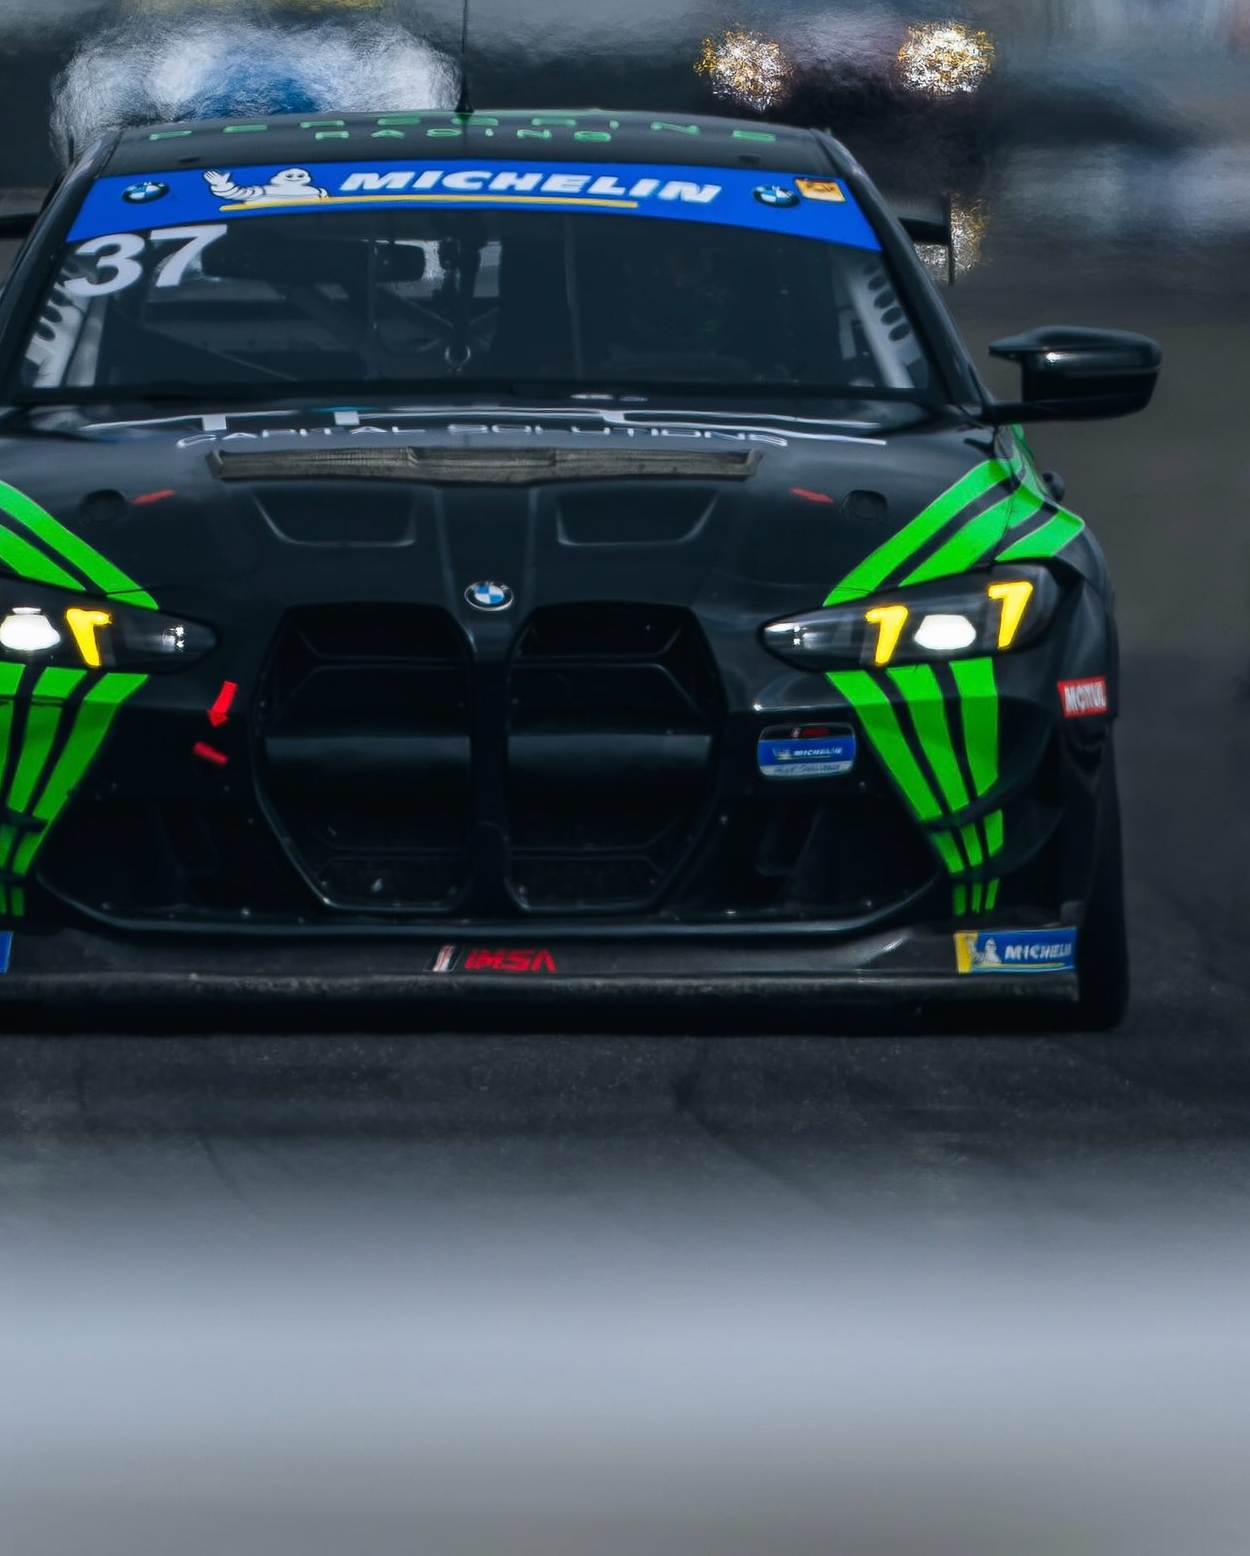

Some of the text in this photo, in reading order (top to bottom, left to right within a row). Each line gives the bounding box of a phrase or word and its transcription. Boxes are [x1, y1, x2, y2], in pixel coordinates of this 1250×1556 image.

[339, 169, 722, 204] MICHELIN
[61, 224, 228, 297] 37
[464, 948, 556, 972] IMSA
